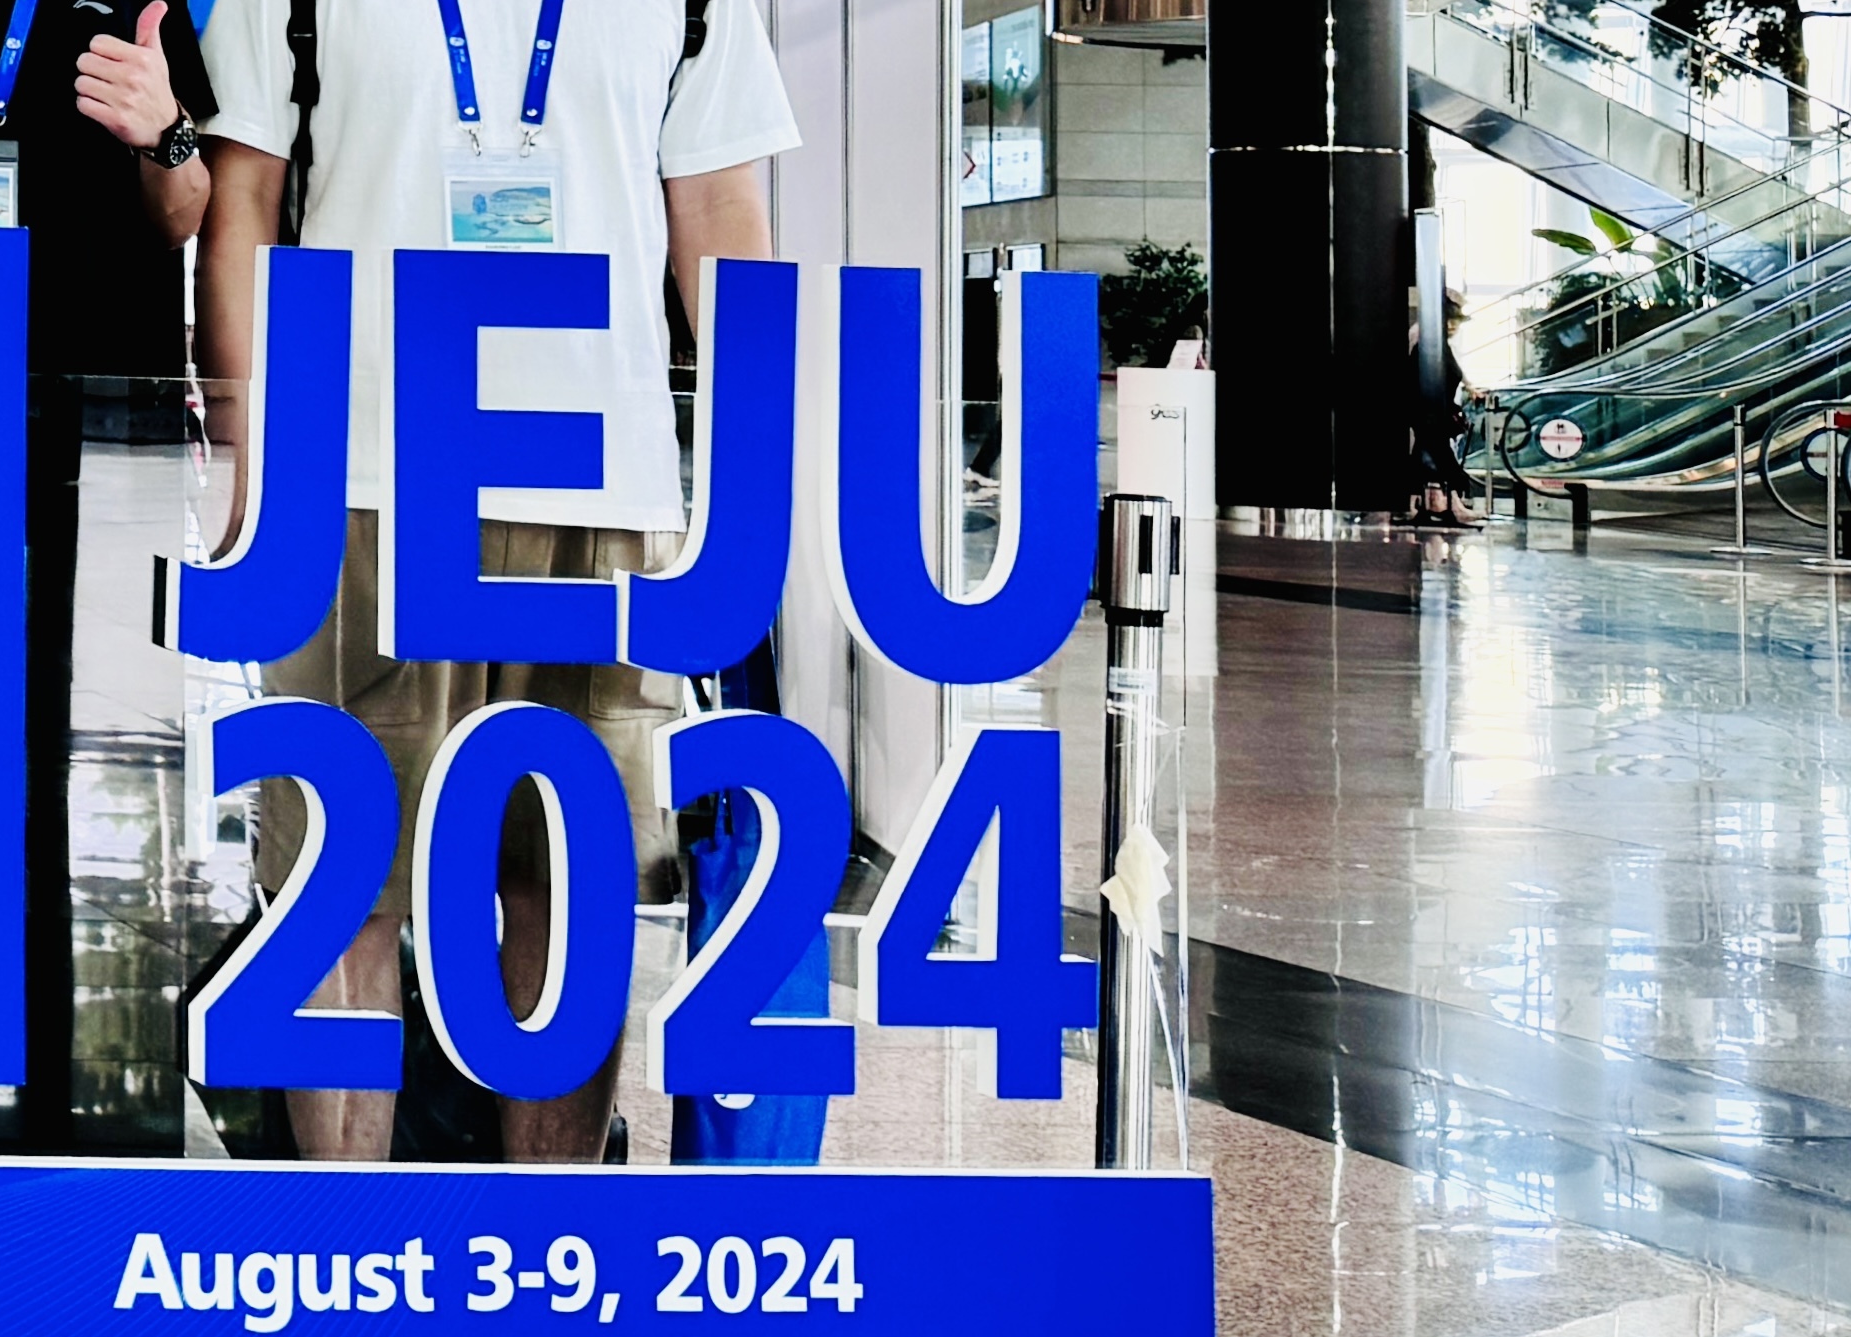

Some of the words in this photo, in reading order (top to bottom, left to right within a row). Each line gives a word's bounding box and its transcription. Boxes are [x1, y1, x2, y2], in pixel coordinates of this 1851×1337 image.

[167, 245, 1100, 686] JEJU
[194, 697, 1100, 1102] 2024
[113, 1233, 435, 1333] August
[467, 1235, 622, 1323] 3-9,
[656, 1235, 865, 1315] 2024
